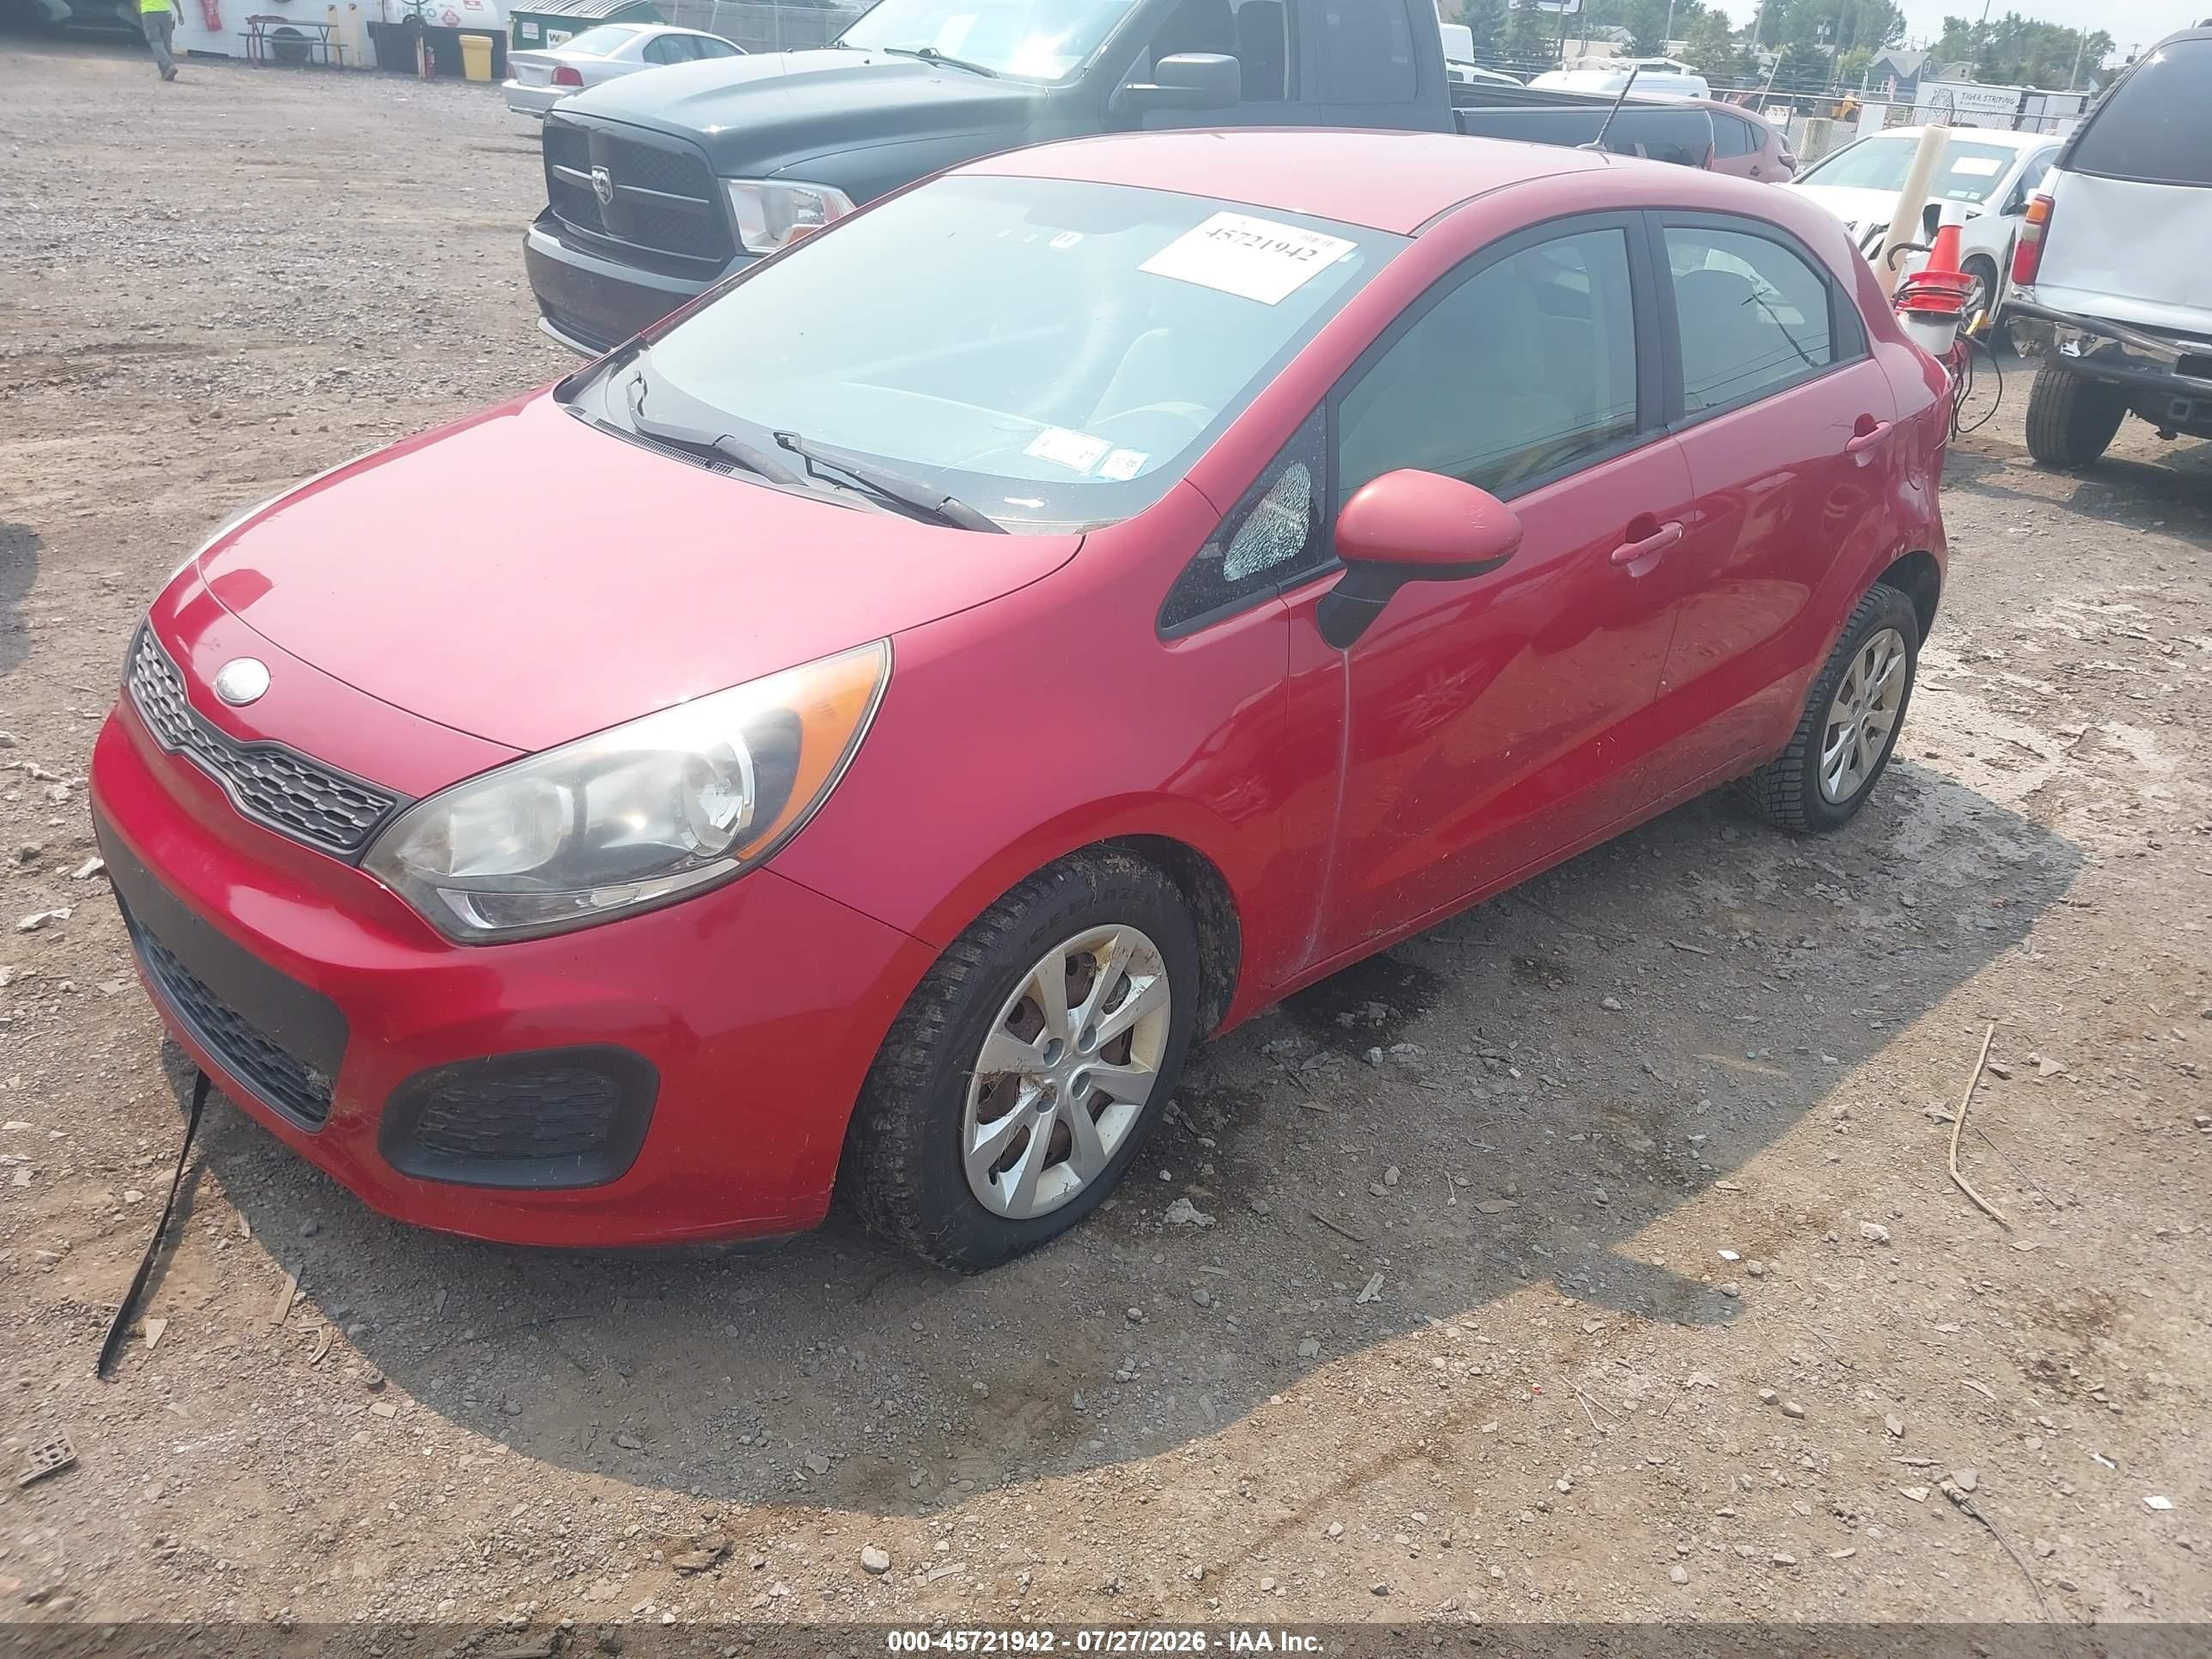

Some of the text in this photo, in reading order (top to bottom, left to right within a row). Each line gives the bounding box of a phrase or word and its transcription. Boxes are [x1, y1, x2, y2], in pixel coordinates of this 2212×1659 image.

[1961, 92, 1981, 102] TIGER
[1983, 94, 2015, 105] STRIPING
[1206, 228, 1318, 261] 45721942
